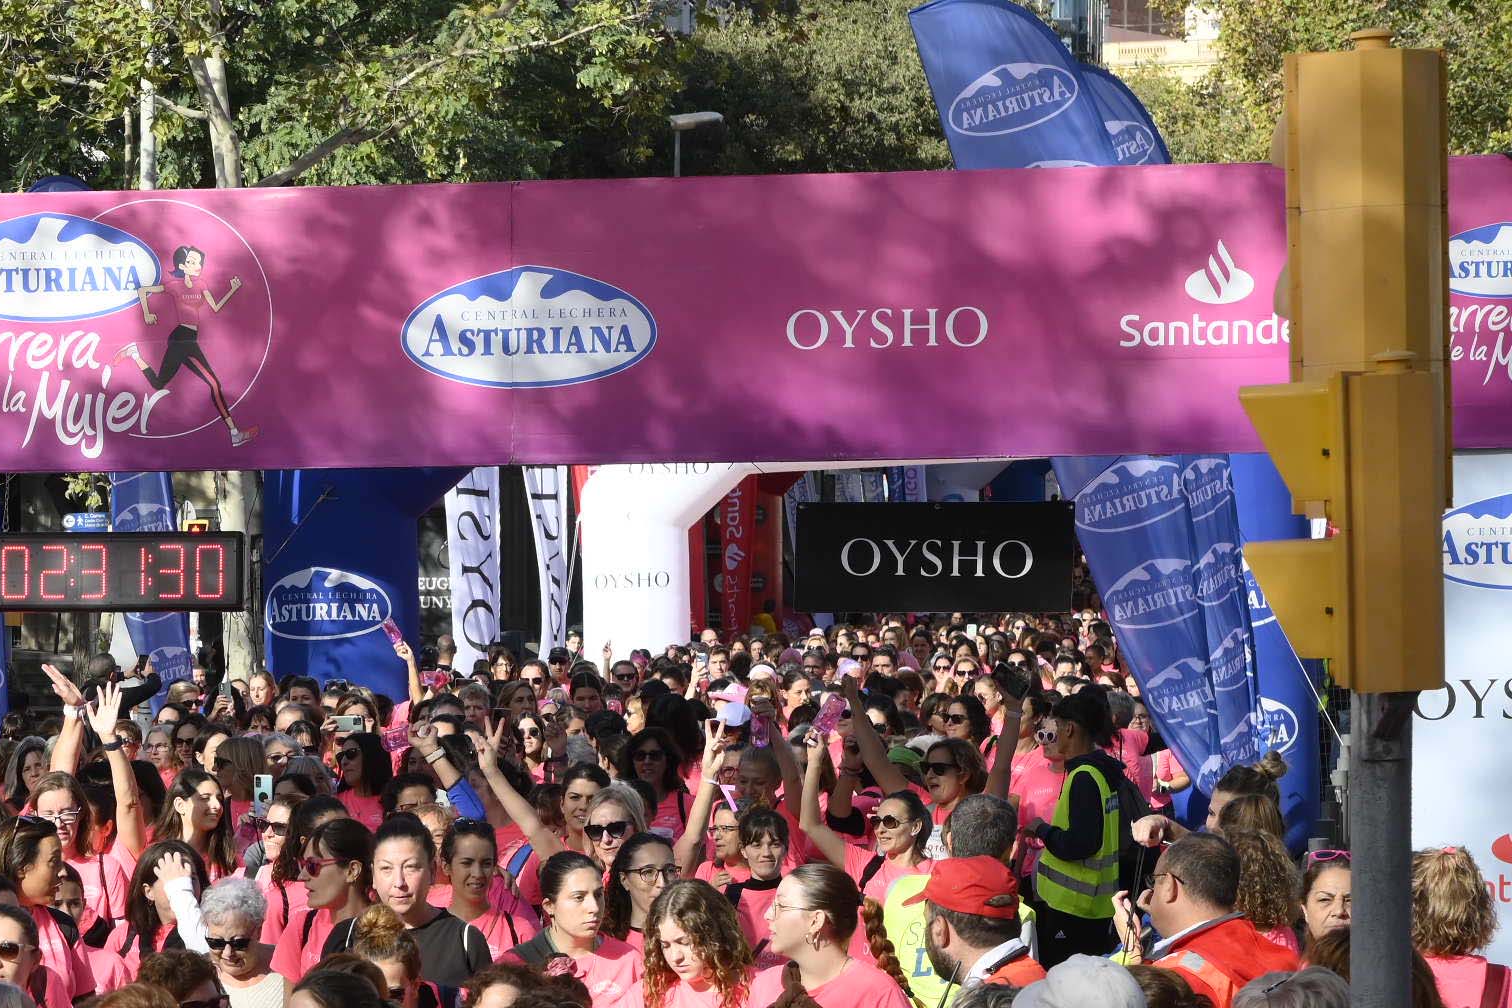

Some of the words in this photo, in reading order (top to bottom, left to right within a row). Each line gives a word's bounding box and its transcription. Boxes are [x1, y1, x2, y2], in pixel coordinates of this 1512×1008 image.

[461, 308, 541, 322] CENTRAL
[548, 306, 628, 319] LECHERA
[786, 306, 988, 350] OYSHO
[421, 313, 638, 358] ASTURIANA
[1119, 313, 1289, 347] Santande
[1469, 334, 1487, 361] la
[2, 375, 26, 414] la
[22, 366, 171, 459] Mujer
[1466, 527, 1512, 536] CENT
[1, 544, 223, 600] 02:31:30
[840, 537, 1033, 579] OYSHO
[595, 571, 670, 588] OYSHO
[269, 595, 382, 624] ASTURIANA
[328, 591, 378, 600] LECHERA
